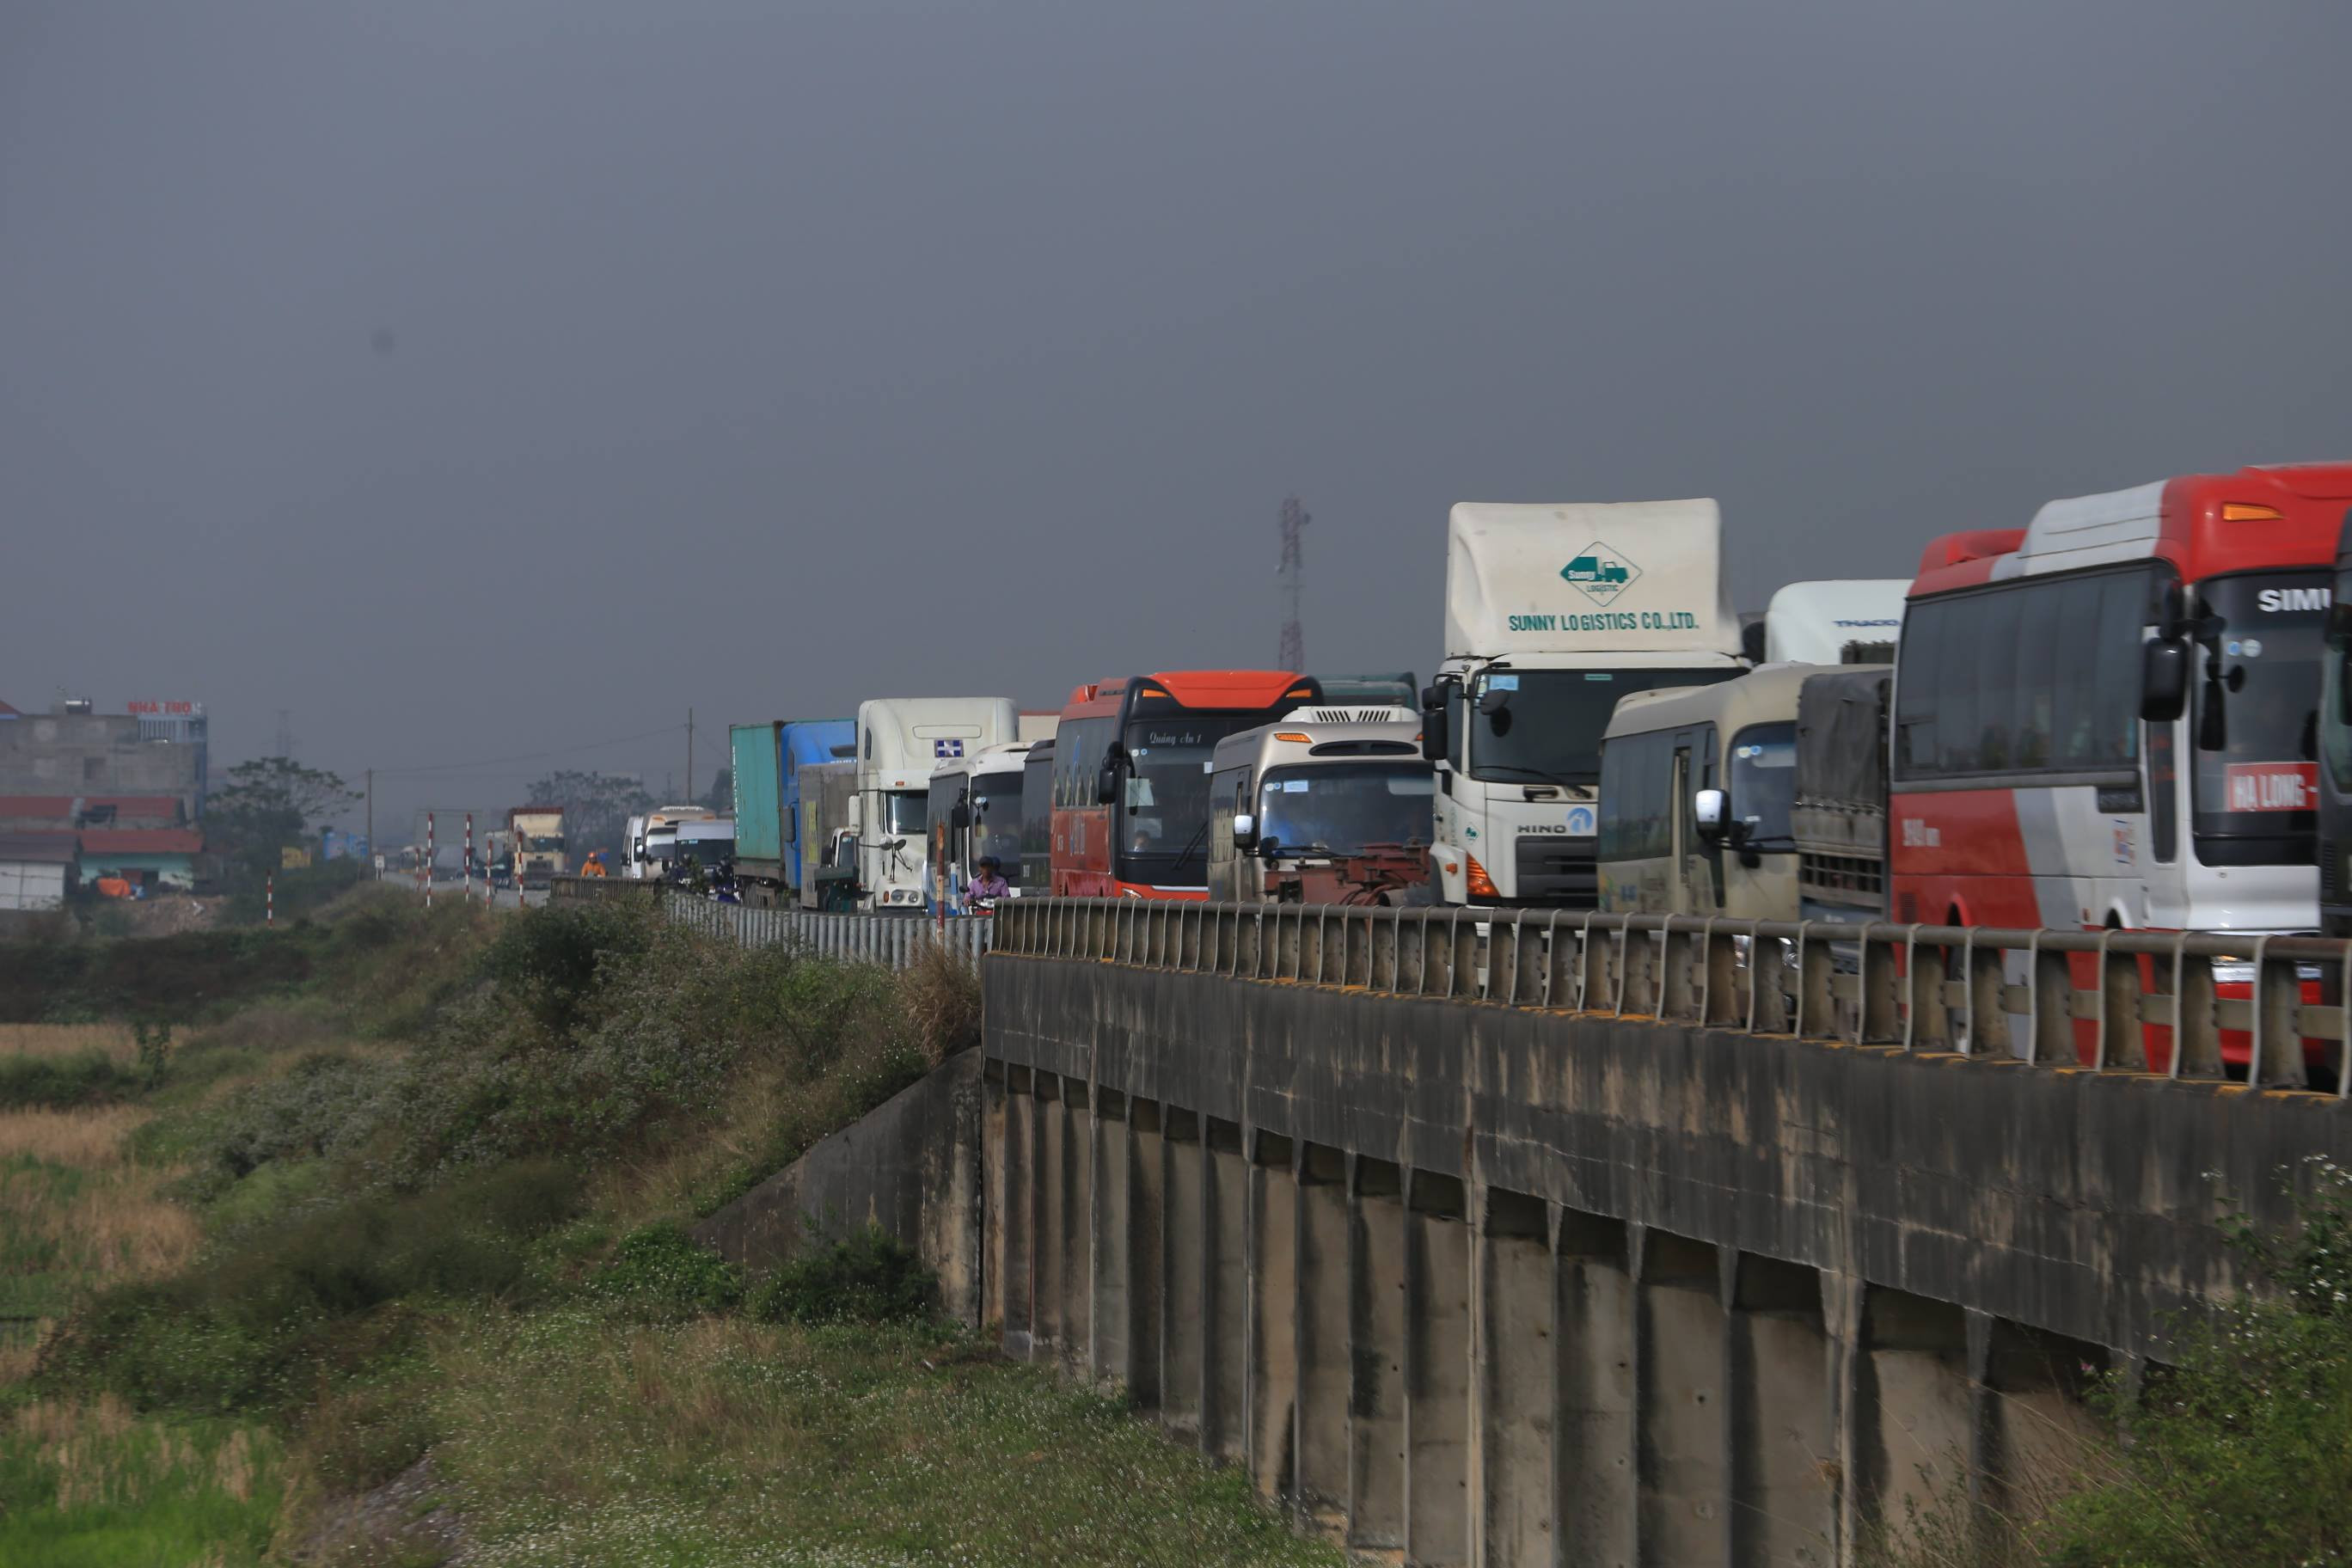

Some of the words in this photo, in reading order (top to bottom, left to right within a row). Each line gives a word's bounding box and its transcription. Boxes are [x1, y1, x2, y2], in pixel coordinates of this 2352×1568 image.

[1567, 570, 1596, 580] Sunny
[1509, 615, 1556, 631] SUNNY
[1561, 614, 1637, 631] LOGISTICS
[2258, 774, 2306, 807] LONG
[1517, 824, 1566, 834] HINO
